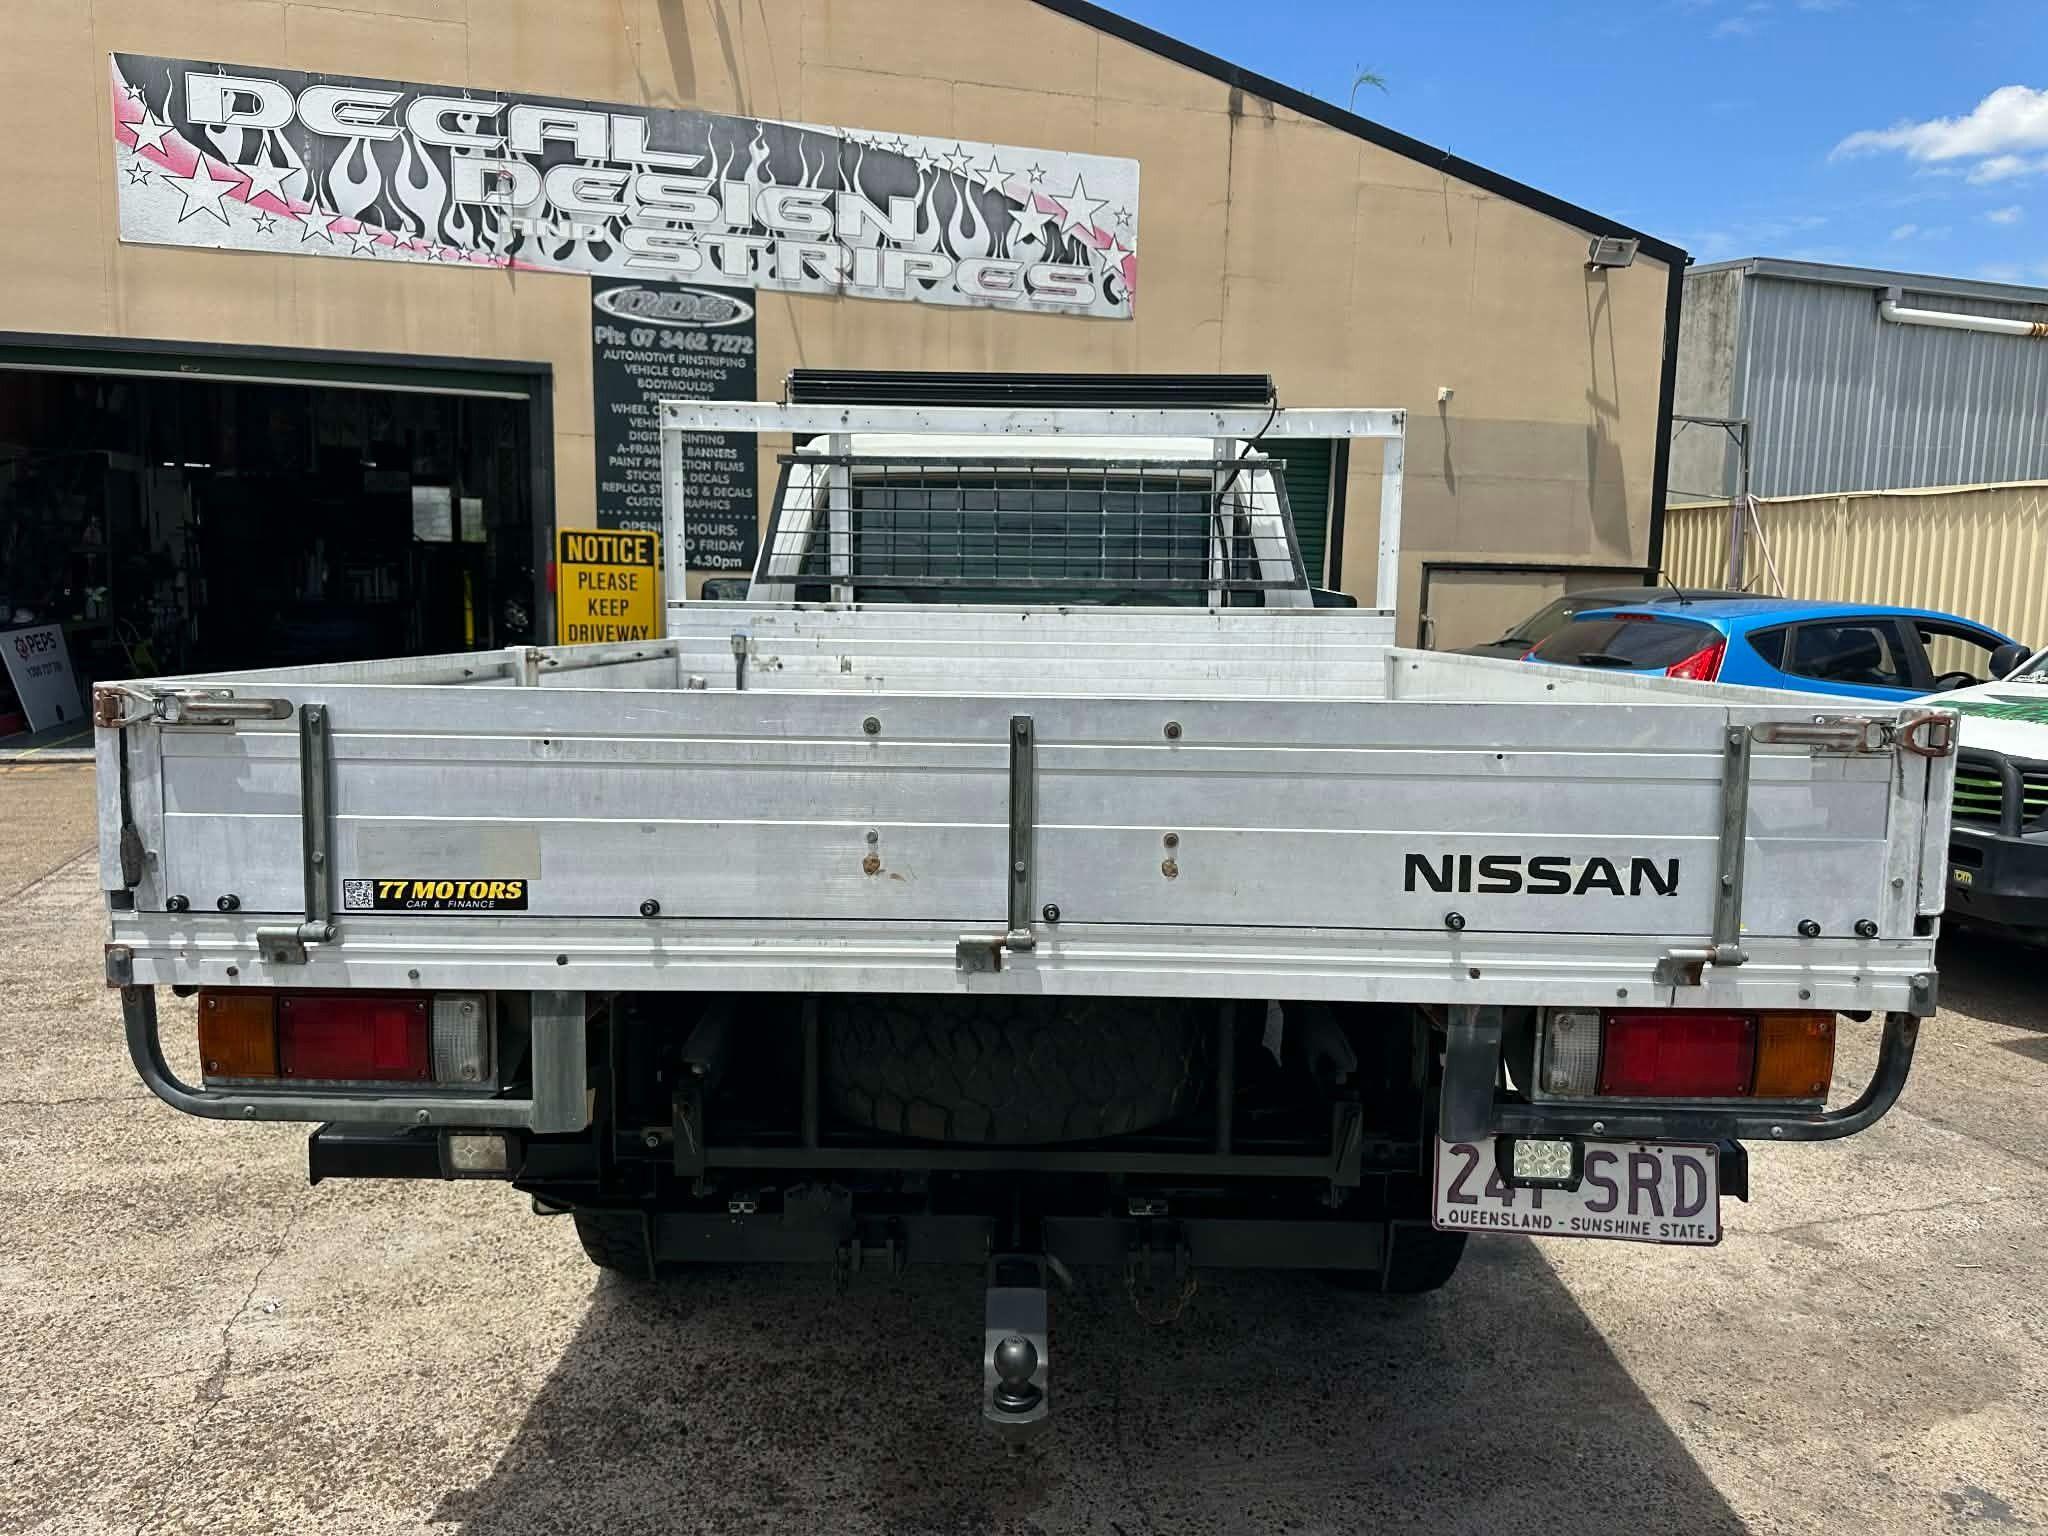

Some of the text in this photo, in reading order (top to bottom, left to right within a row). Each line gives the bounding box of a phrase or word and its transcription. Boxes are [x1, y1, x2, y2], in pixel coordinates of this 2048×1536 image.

[185, 71, 704, 170] DECAL
[451, 156, 917, 242] DESIGN
[500, 216, 605, 242] AND
[620, 226, 1098, 305] STRIPES
[630, 327, 656, 348] 07
[659, 330, 709, 351] 3462
[603, 350, 746, 368] AUTOMOTIVE PINSTRIPING
[624, 364, 727, 380] VEHICLE GRAPHICS
[637, 377, 715, 393] BODYMOULDS
[611, 402, 650, 415] WHEEL
[681, 433, 725, 446] RINTING
[687, 447, 737, 460] BANNERS
[609, 457, 642, 468] PAINT
[714, 461, 745, 473] FILMS
[690, 473, 730, 485] DECALS
[602, 481, 646, 495] REPLICA
[701, 487, 711, 497] &
[713, 487, 753, 499] DECALS
[684, 499, 731, 511] RAPHICS
[687, 523, 739, 537] HOURS:
[567, 535, 648, 564] NOTICE
[699, 540, 745, 552] FRIDAY
[692, 554, 743, 570] 4.30pm
[578, 571, 638, 592] PLEASE
[588, 598, 629, 617] KEEP
[568, 623, 649, 642] DRIVEWAY
[1404, 853, 1680, 897] NISSAN
[378, 881, 523, 900] 77 MOTORS
[406, 900, 496, 908] CAR & FINANCE
[1446, 1143, 1707, 1218] 24 SRD
[1448, 1209, 1553, 1229] QUEENSLAND
[1570, 1217, 1651, 1236] SUNSHINE
[1659, 1223, 1706, 1239] STATE
